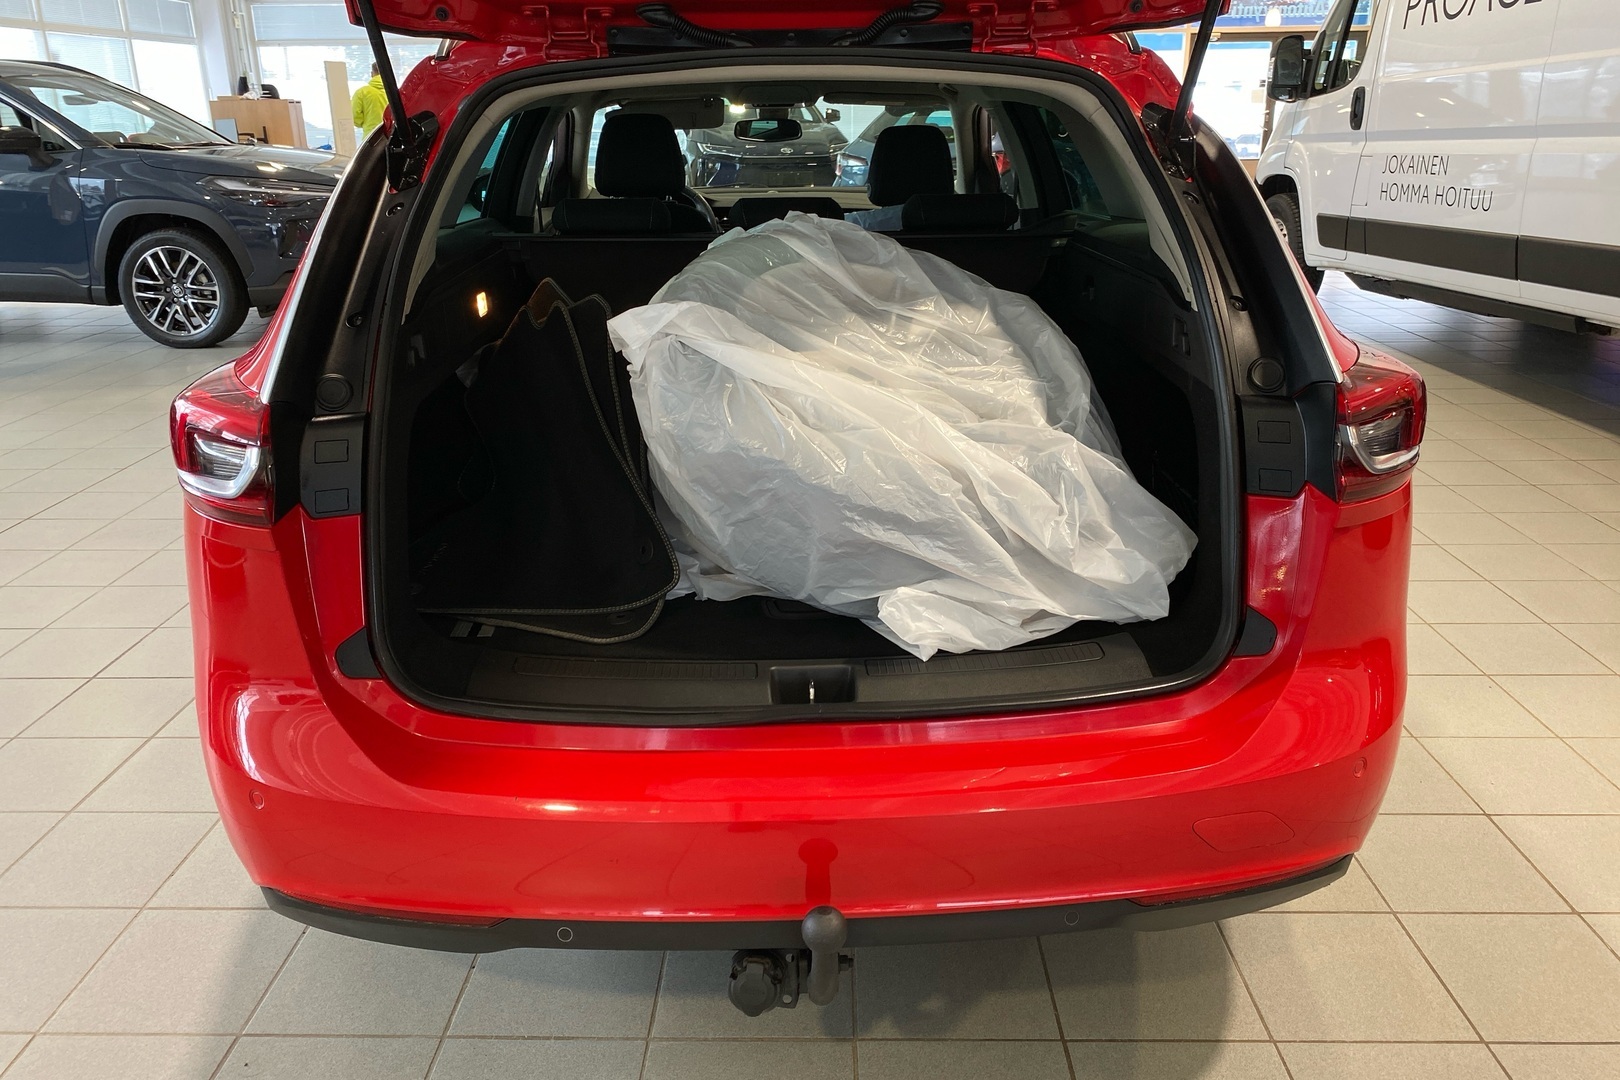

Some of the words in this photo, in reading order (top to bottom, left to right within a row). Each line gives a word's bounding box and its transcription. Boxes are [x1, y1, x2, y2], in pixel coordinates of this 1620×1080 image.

[1403, 0, 1541, 29] PRO
[1382, 155, 1450, 176] JOKAINEN
[1380, 183, 1429, 204] HOMMA
[1434, 185, 1493, 212] HOITUU
